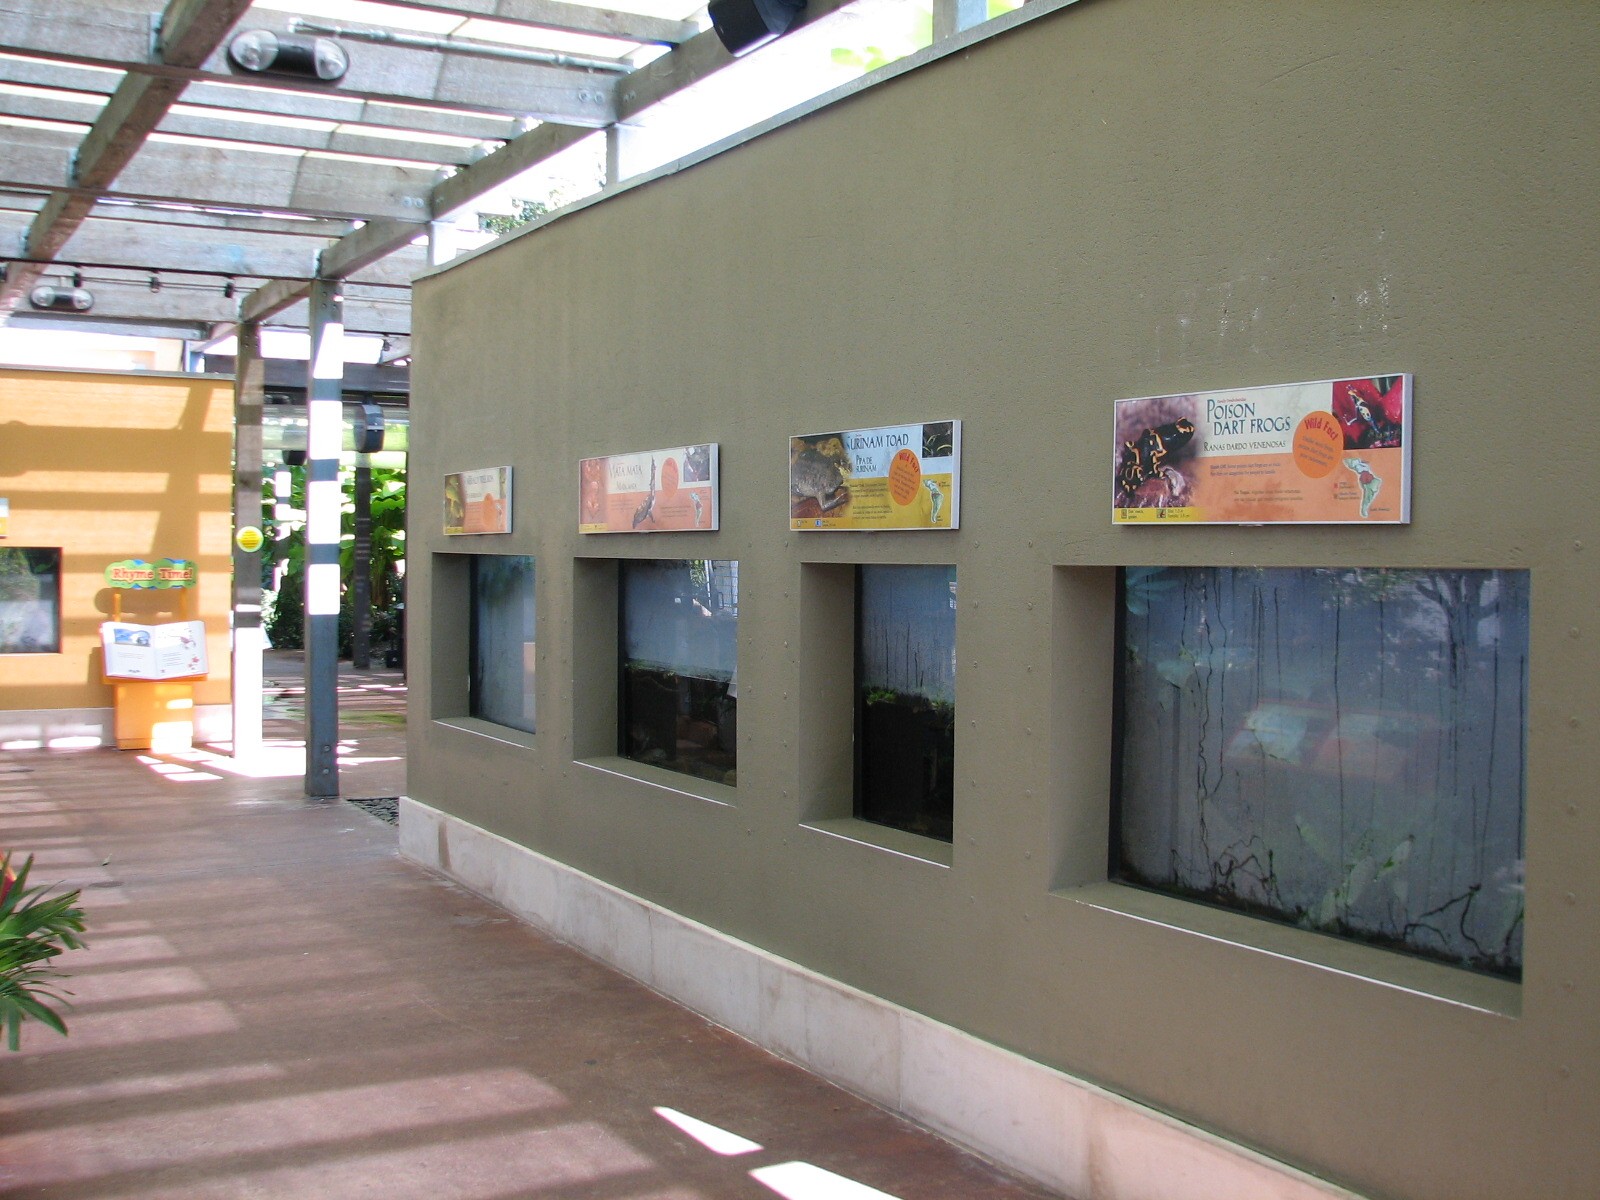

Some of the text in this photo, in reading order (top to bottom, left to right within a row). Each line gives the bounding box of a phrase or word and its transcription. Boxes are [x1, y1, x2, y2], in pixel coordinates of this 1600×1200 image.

[1206, 398, 1256, 423] POISON
[1213, 415, 1291, 436] DART FROGS
[1304, 417, 1321, 431] Wild
[886, 433, 909, 447] TOAD
[1203, 440, 1287, 452] RANAS DARDO VENENOSAS
[112, 567, 193, 581] Rhyme Time!
